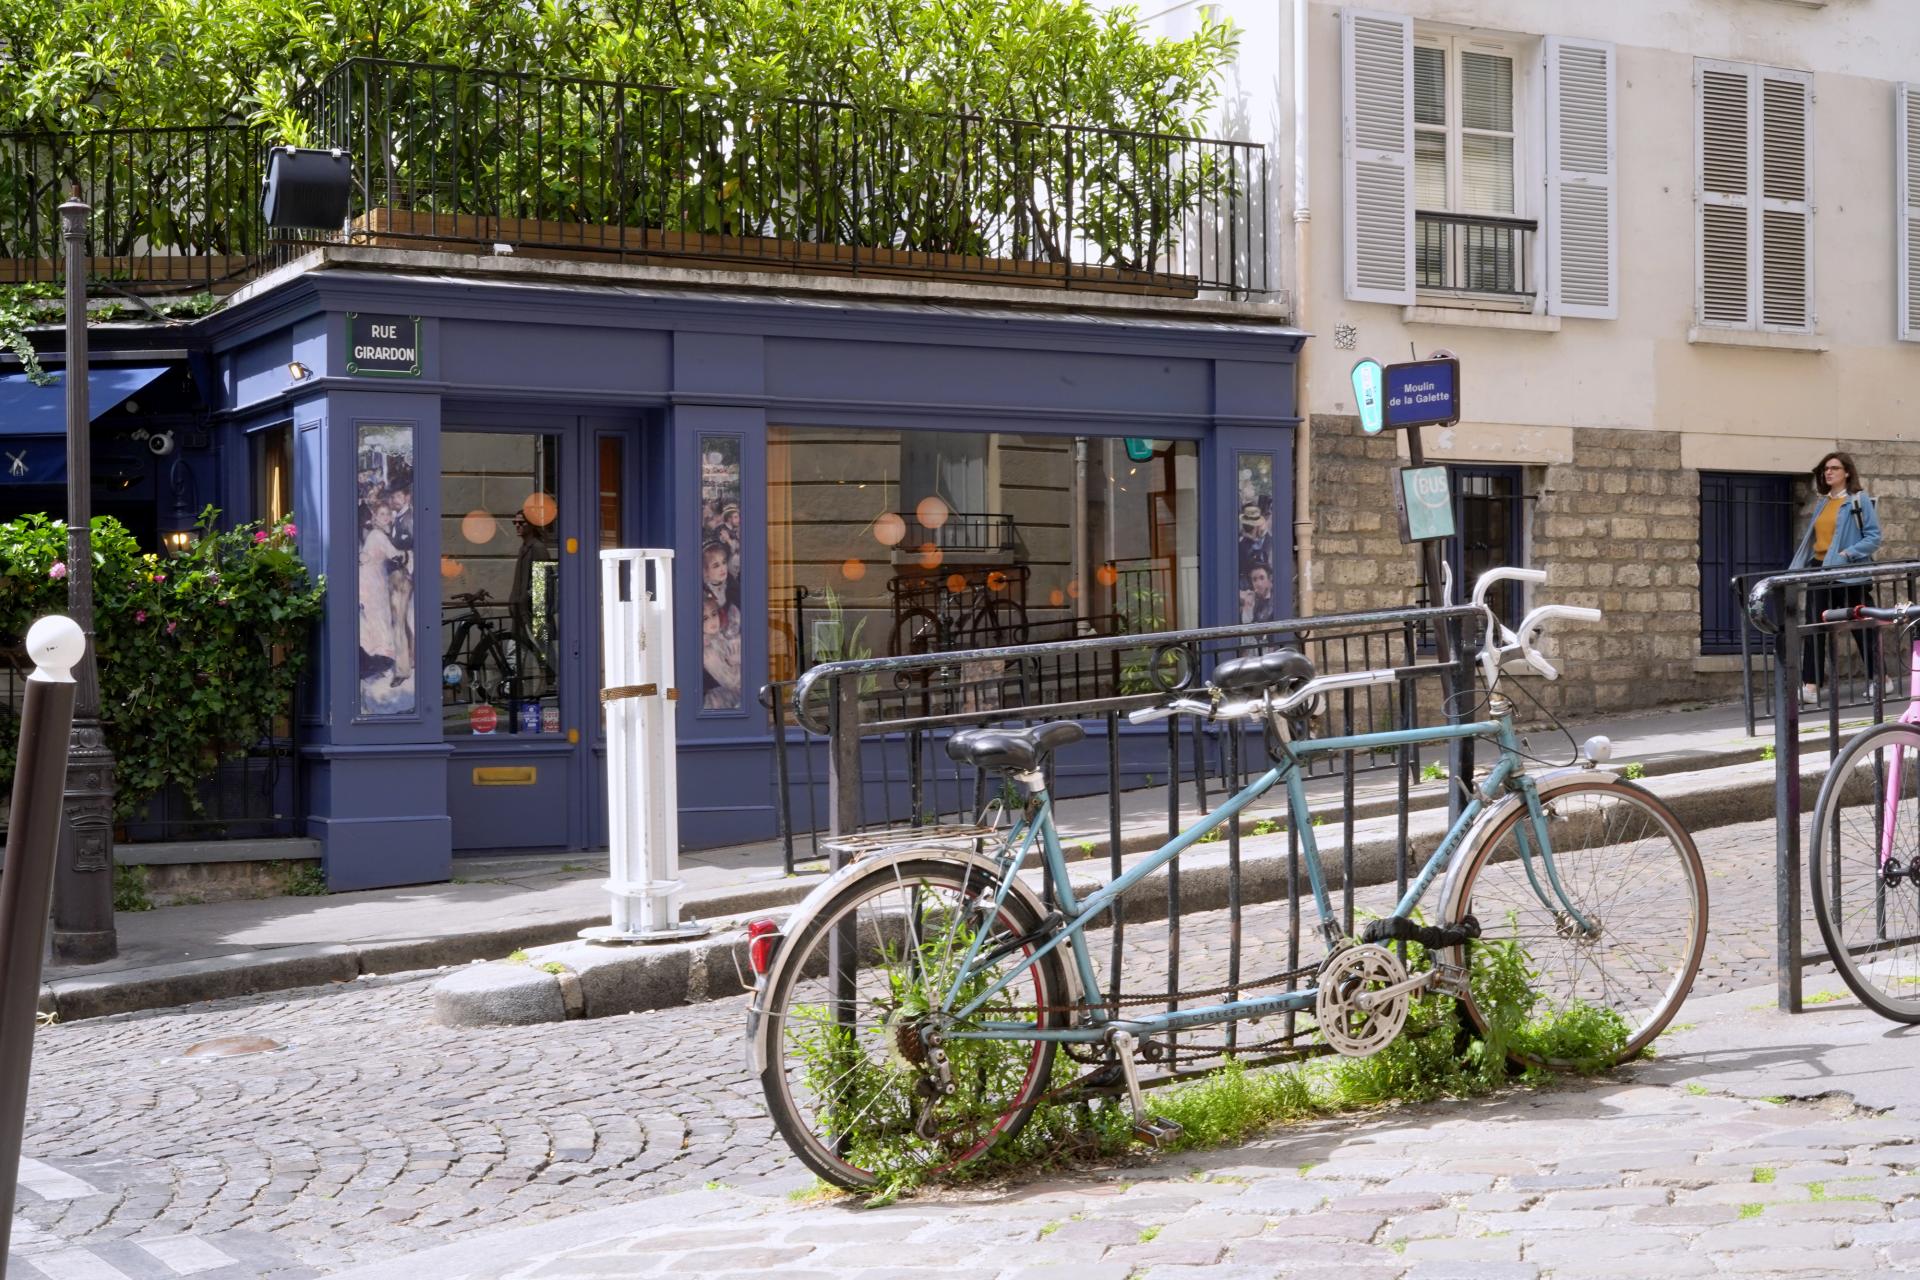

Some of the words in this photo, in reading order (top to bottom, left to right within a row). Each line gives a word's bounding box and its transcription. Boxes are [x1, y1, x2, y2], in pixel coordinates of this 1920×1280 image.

[371, 324, 398, 339] RUE
[354, 345, 415, 362] GIRARDON
[1404, 382, 1435, 393] Moulin
[1389, 397, 1401, 406] de
[1404, 395, 1413, 405] la
[1415, 392, 1450, 404] Galette
[1419, 475, 1448, 495] BUS
